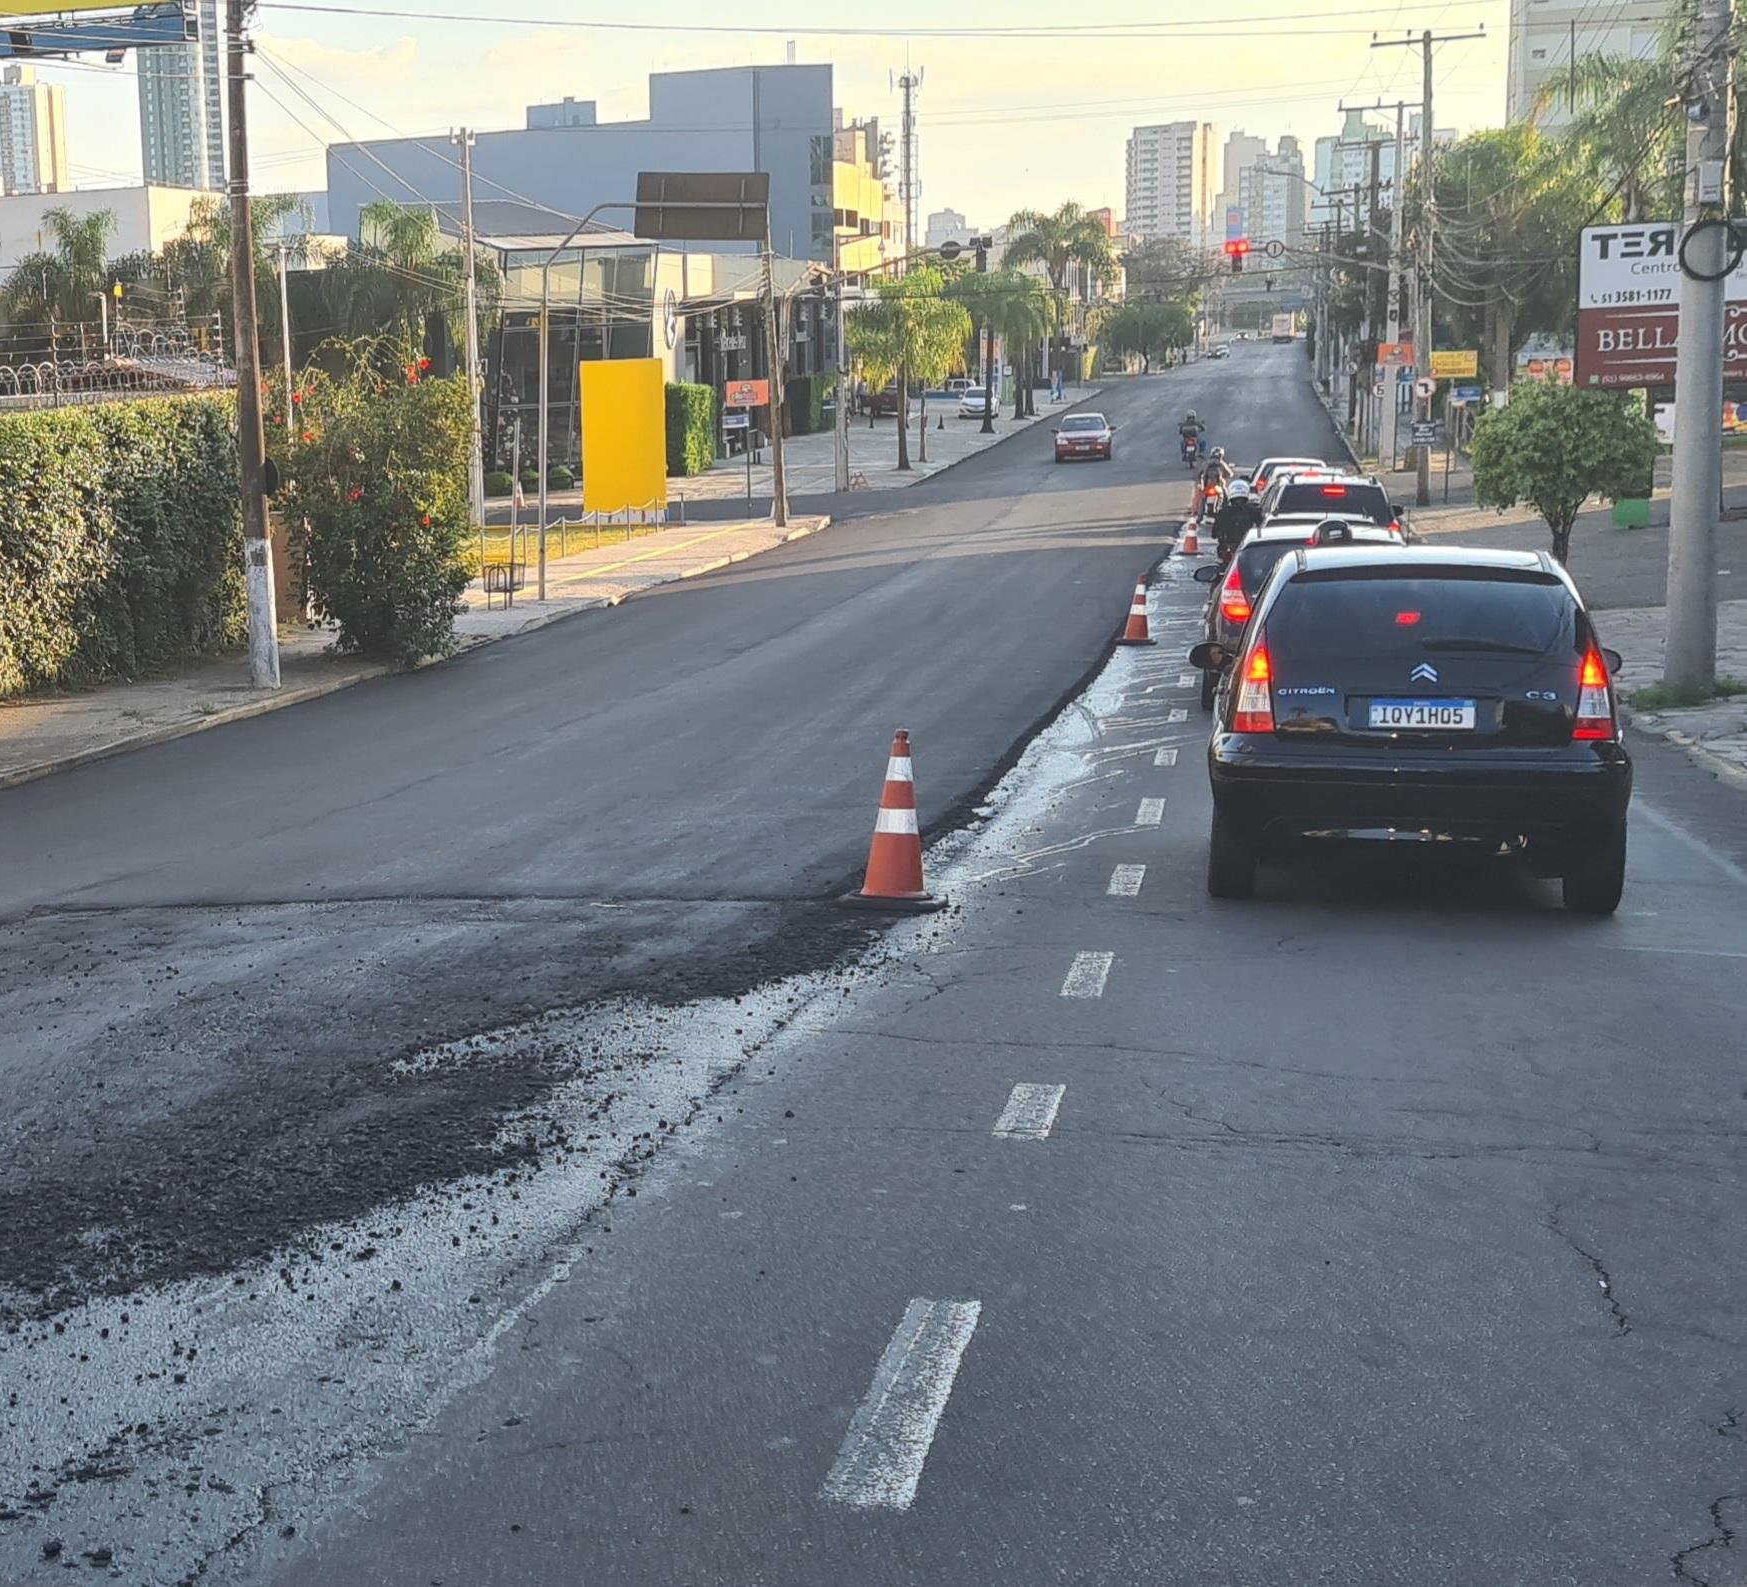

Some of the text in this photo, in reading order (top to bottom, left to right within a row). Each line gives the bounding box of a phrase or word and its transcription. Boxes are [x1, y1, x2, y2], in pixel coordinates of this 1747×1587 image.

[1615, 288, 1672, 303] 3581-1177
[1277, 686, 1336, 696] CITROËN
[1525, 690, 1557, 700] C3
[1379, 706, 1464, 725] IQY1H05
